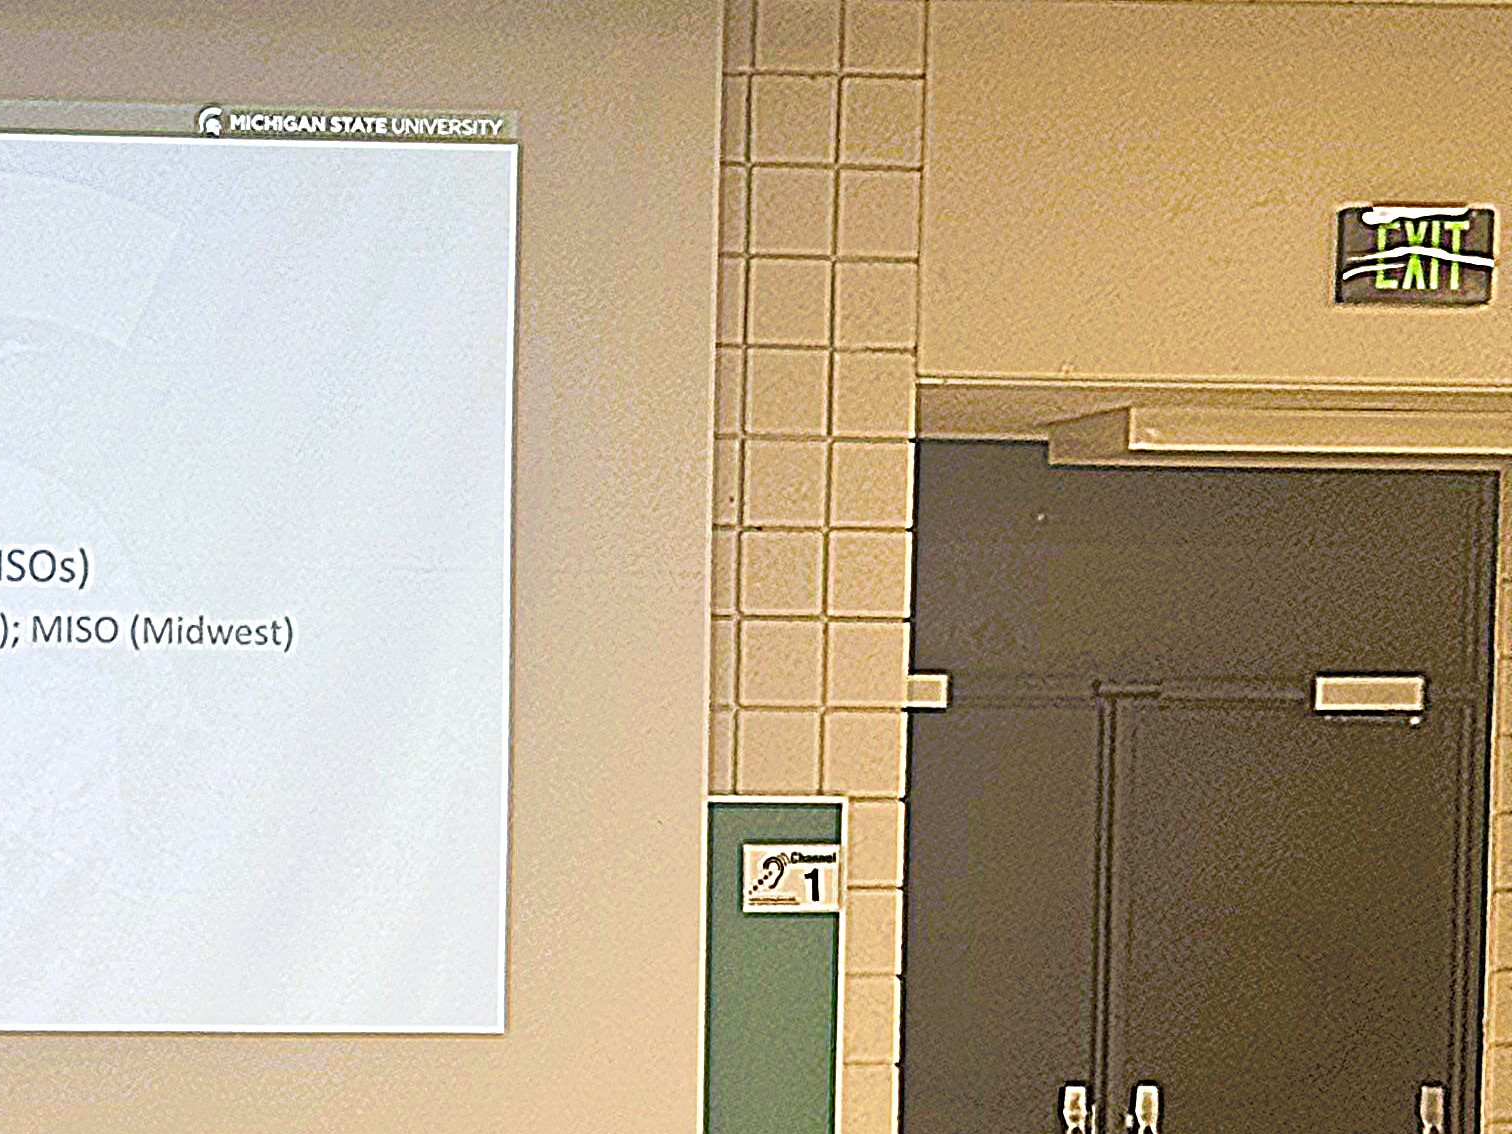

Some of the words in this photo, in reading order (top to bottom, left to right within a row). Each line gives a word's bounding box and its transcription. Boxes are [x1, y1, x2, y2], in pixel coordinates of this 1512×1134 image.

[230, 114, 326, 132] MICHIGAN
[330, 117, 386, 134] STATE
[392, 119, 503, 136] UNIVERSITY
[1375, 220, 1470, 290] EXIT
[33, 616, 118, 643] MISO
[131, 614, 292, 652] (Midwest)
[790, 852, 836, 864] Channel
[804, 868, 820, 902] 1
